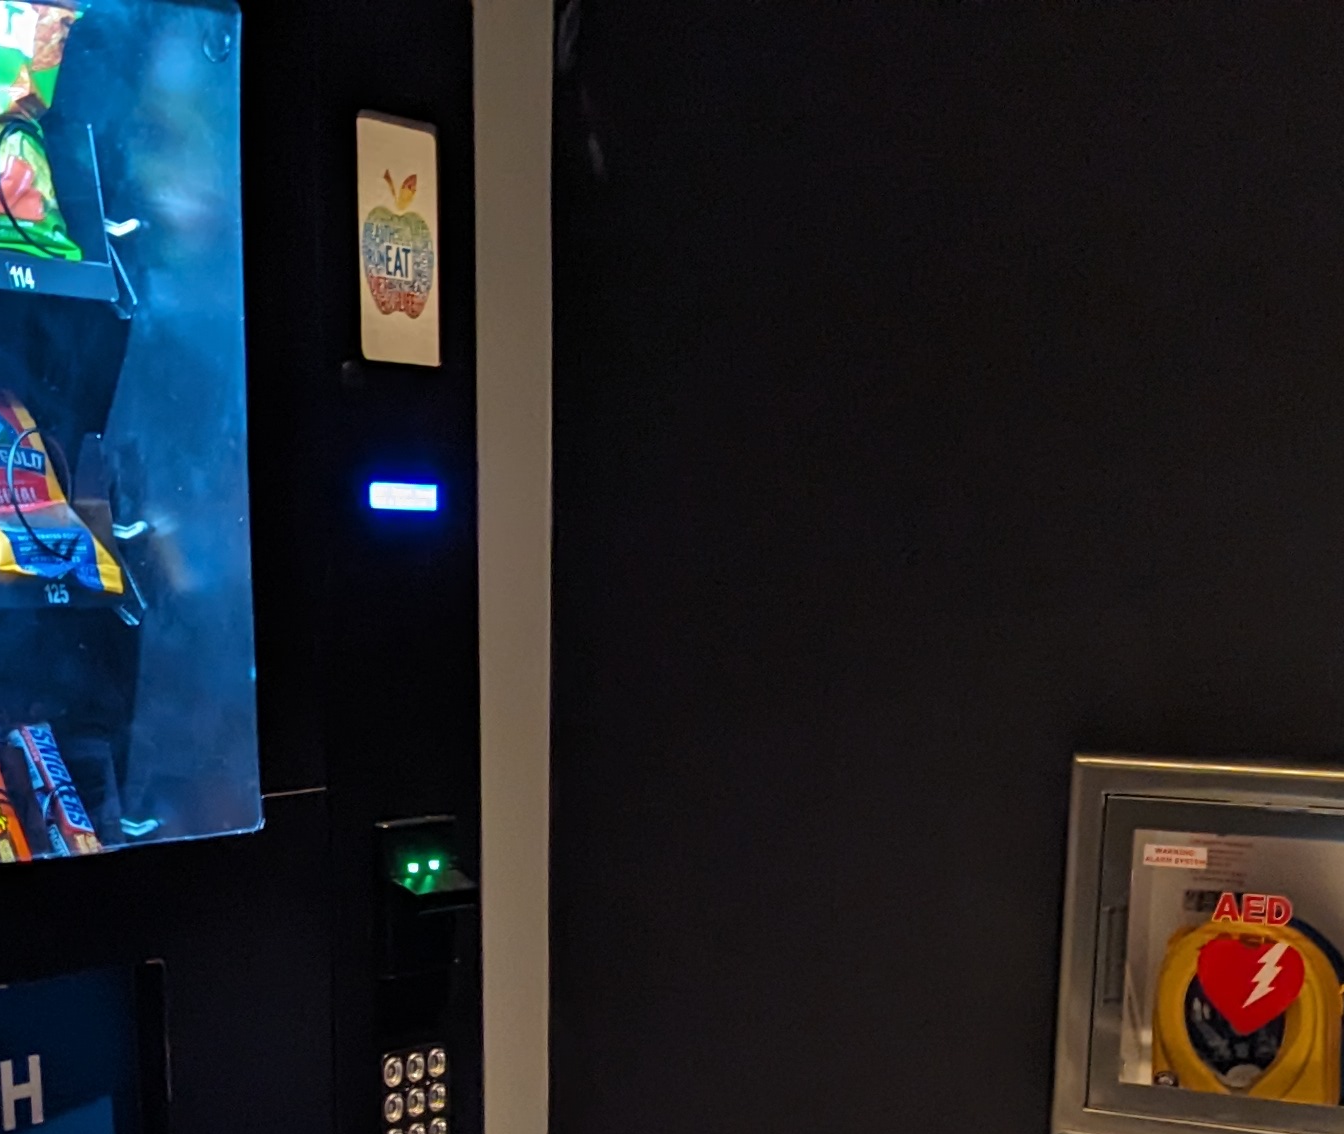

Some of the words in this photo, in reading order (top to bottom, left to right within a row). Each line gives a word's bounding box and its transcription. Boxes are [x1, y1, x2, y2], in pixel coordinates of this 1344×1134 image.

[9, 264, 35, 290] 114
[385, 244, 411, 279] EAT
[44, 583, 70, 604] 125
[28, 724, 93, 830] SNICKERS
[1212, 891, 1293, 927] AED
